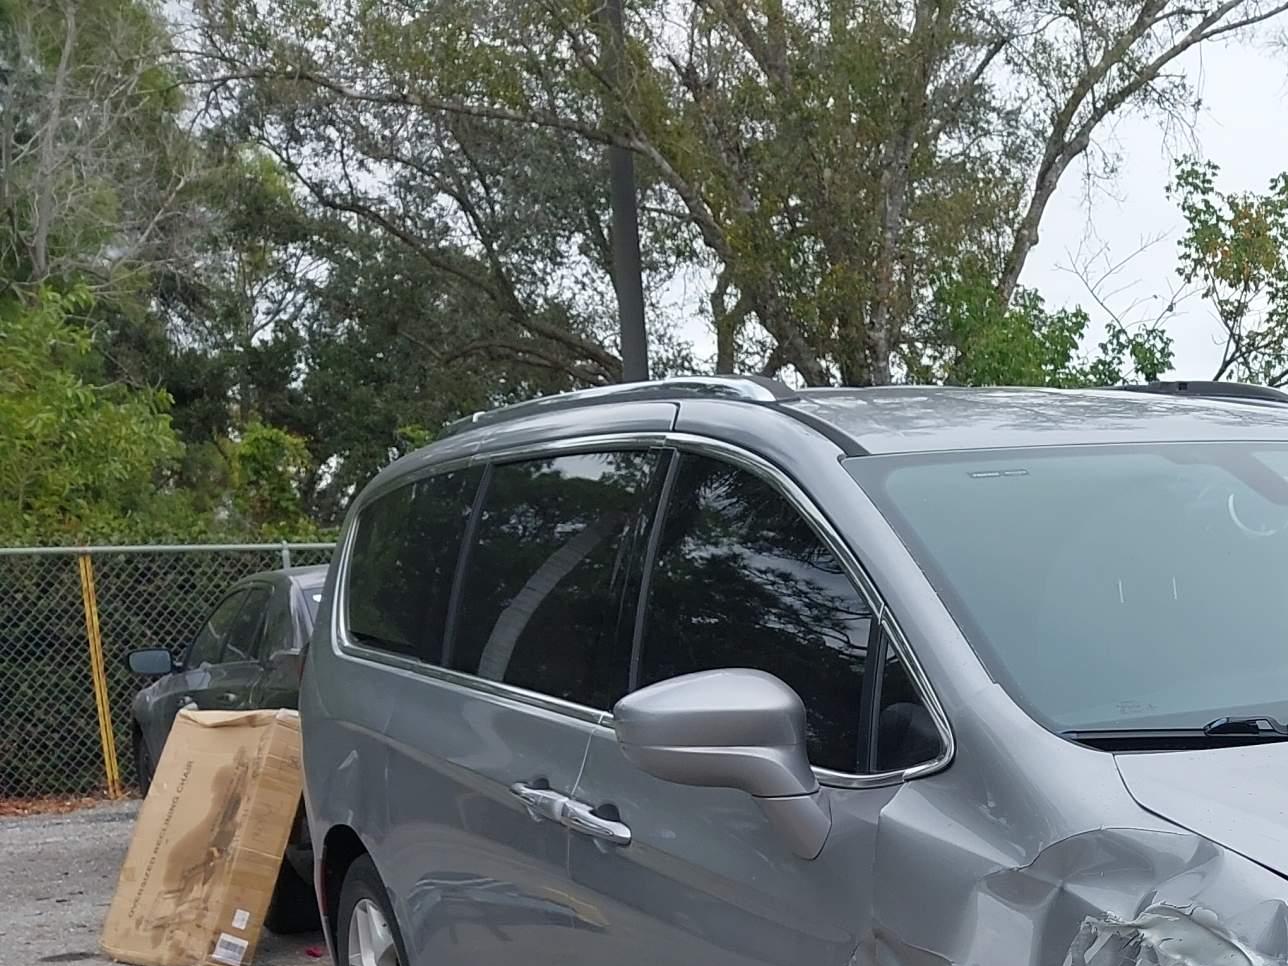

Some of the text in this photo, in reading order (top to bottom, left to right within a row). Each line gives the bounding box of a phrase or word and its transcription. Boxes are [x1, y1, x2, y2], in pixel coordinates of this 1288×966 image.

[128, 760, 194, 919] OVERSIZED RECLINING CHAIR
